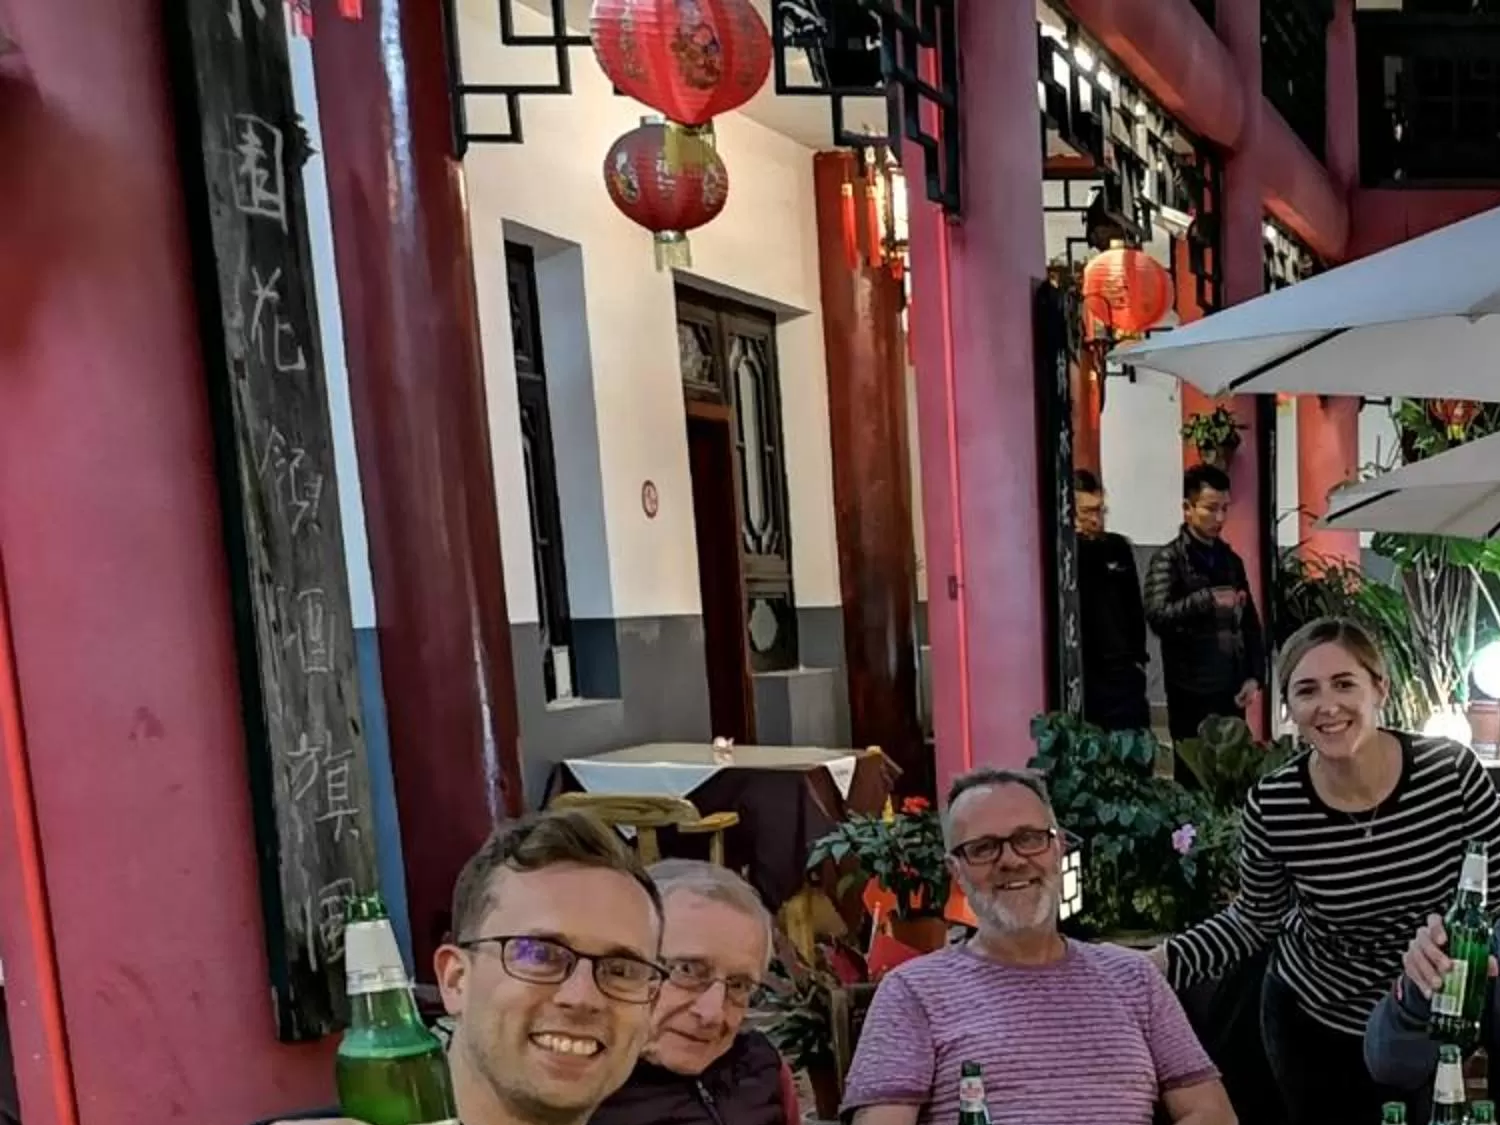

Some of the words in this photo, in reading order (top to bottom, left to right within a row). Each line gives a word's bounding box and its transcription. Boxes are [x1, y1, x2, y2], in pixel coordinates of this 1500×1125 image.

[222, 0, 360, 973] 園花領酒旗風
